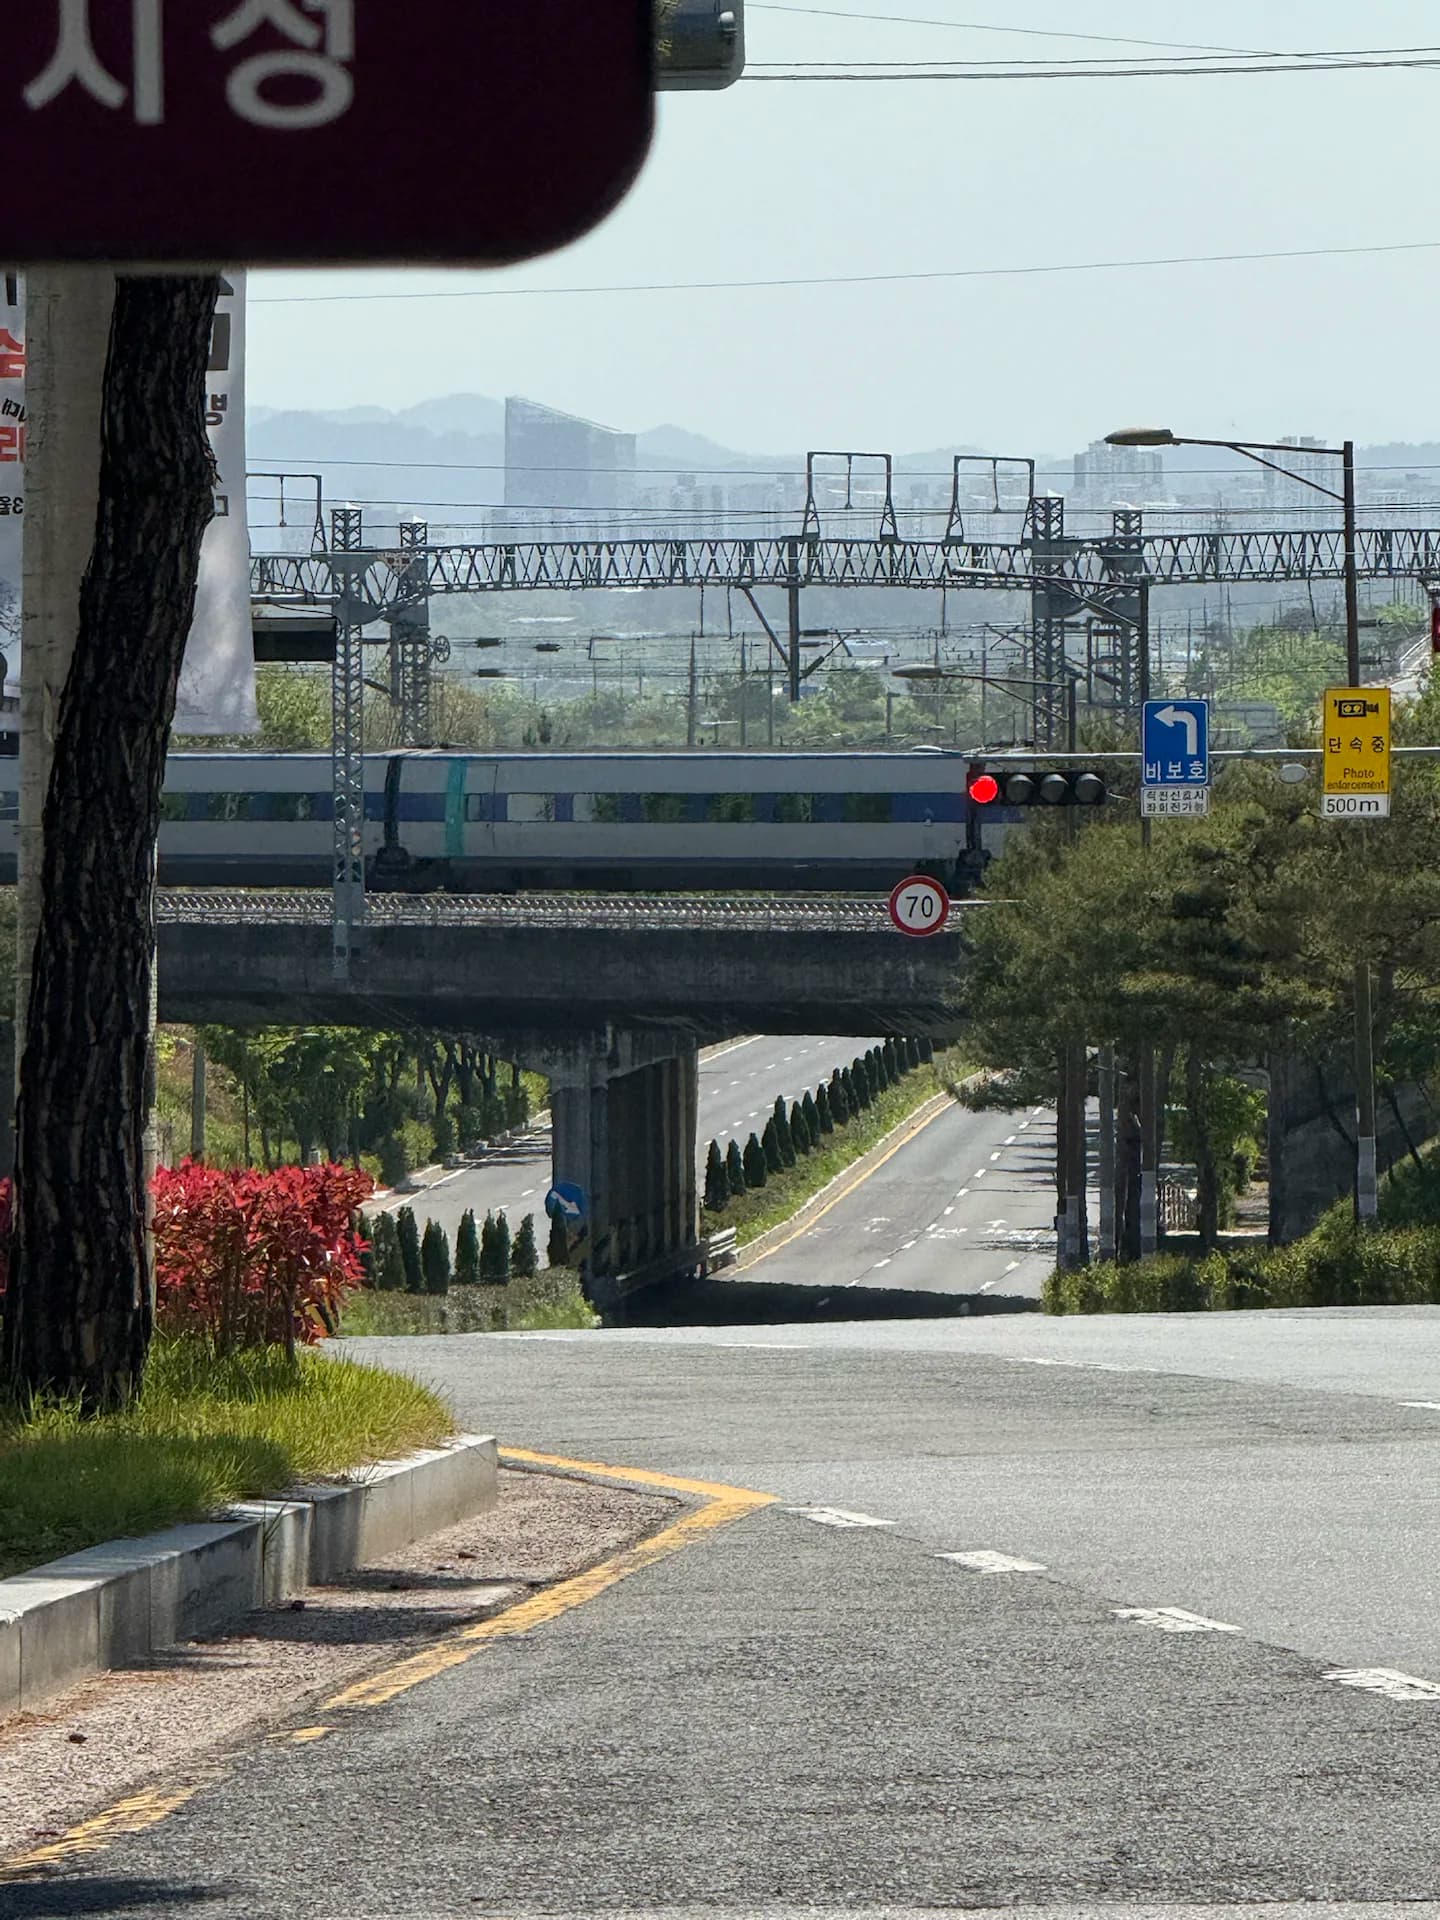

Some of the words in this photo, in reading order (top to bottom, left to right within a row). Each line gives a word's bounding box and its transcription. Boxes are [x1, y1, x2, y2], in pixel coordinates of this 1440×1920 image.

[1146, 760, 1206, 781] 비보호
[1343, 768, 1375, 779] Photo
[1327, 780, 1385, 790] enforcement
[906, 895, 933, 918] 70
